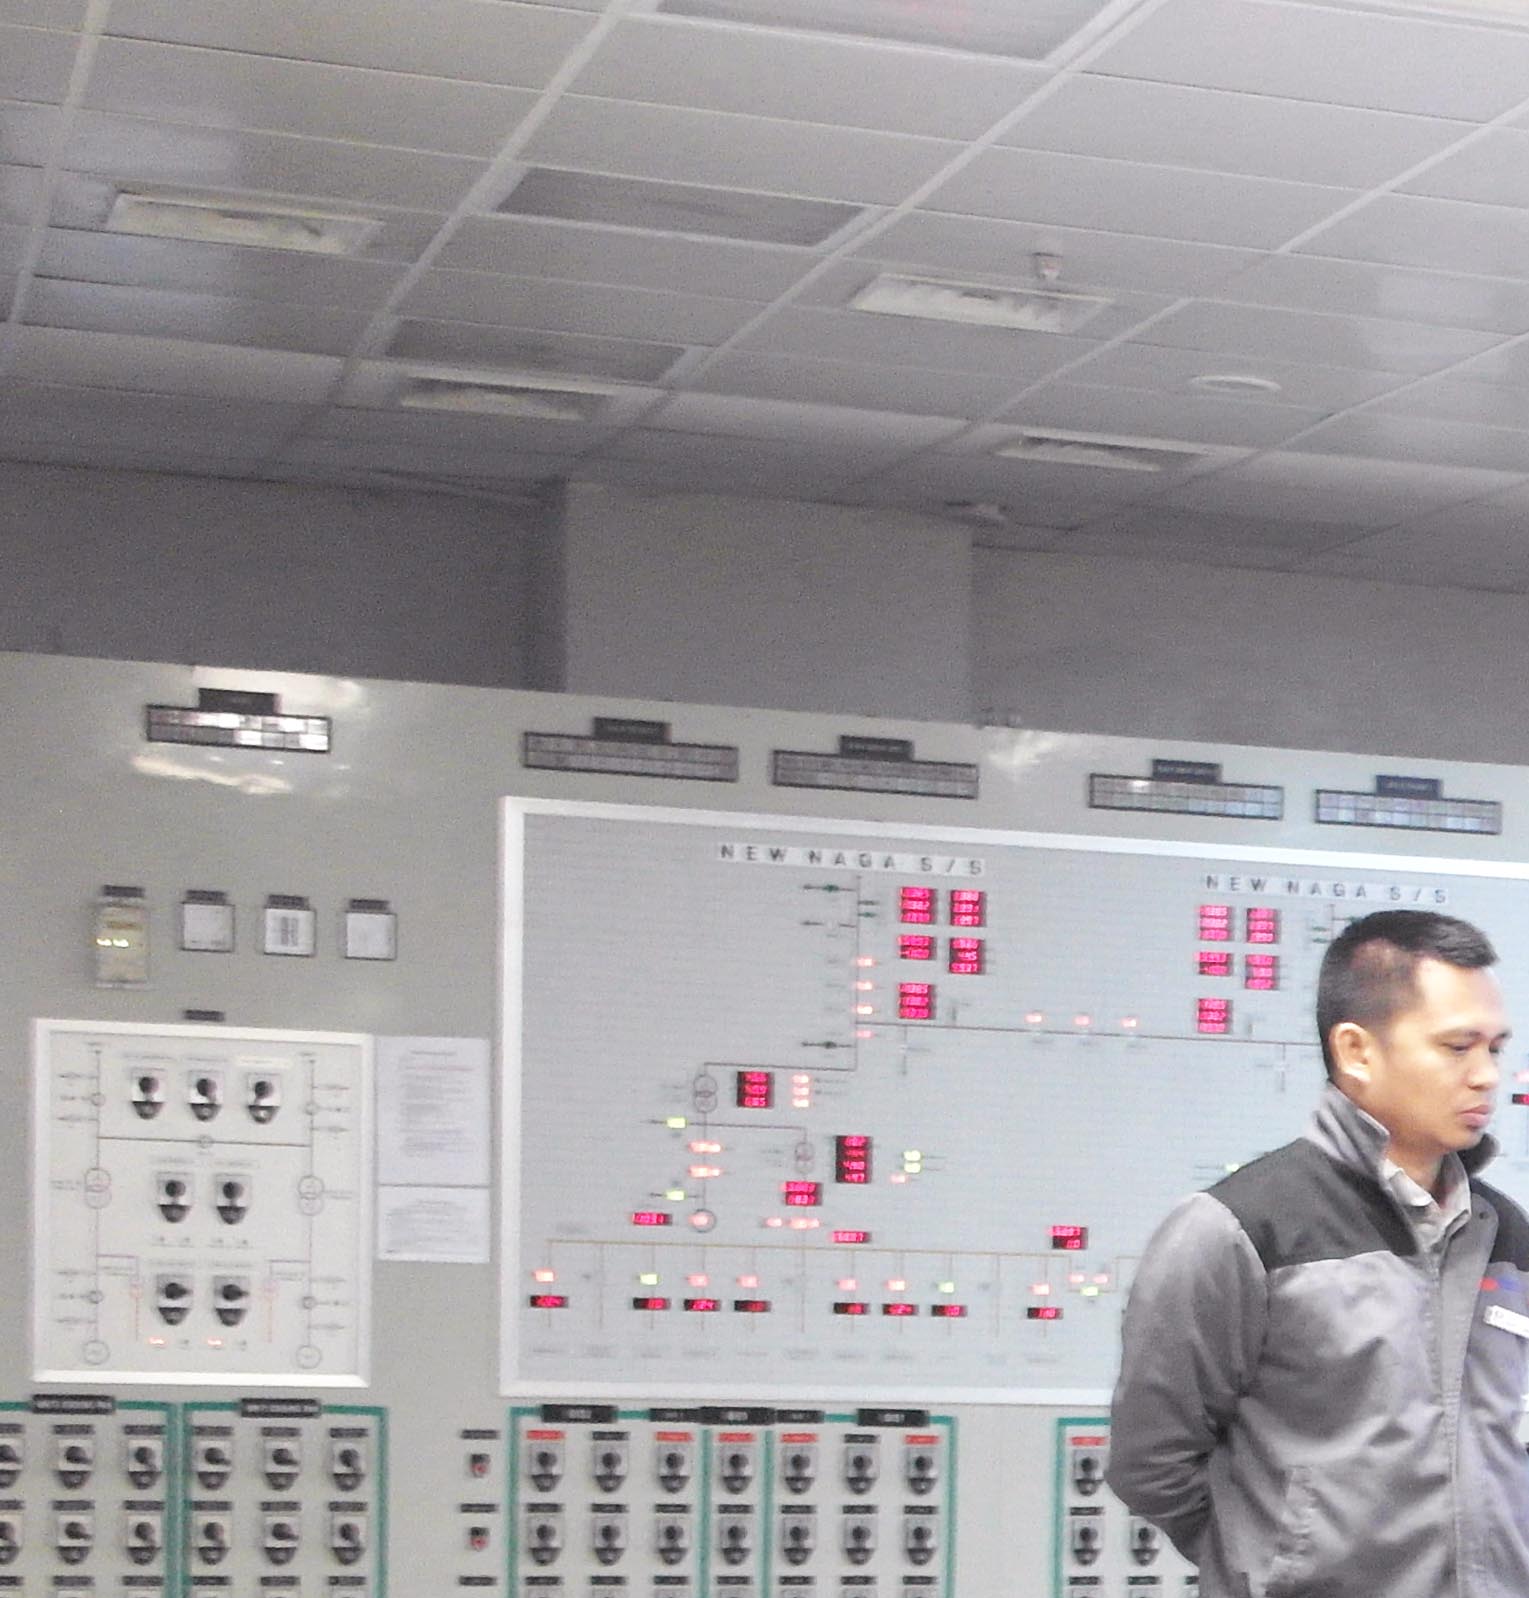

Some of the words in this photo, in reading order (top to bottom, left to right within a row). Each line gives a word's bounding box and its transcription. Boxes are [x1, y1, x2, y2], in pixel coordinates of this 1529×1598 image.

[720, 846, 786, 862] NEW
[808, 850, 896, 868] NAGA
[920, 856, 983, 875] S/S
[1205, 875, 1268, 892] NEW
[1287, 881, 1368, 899] NAGA
